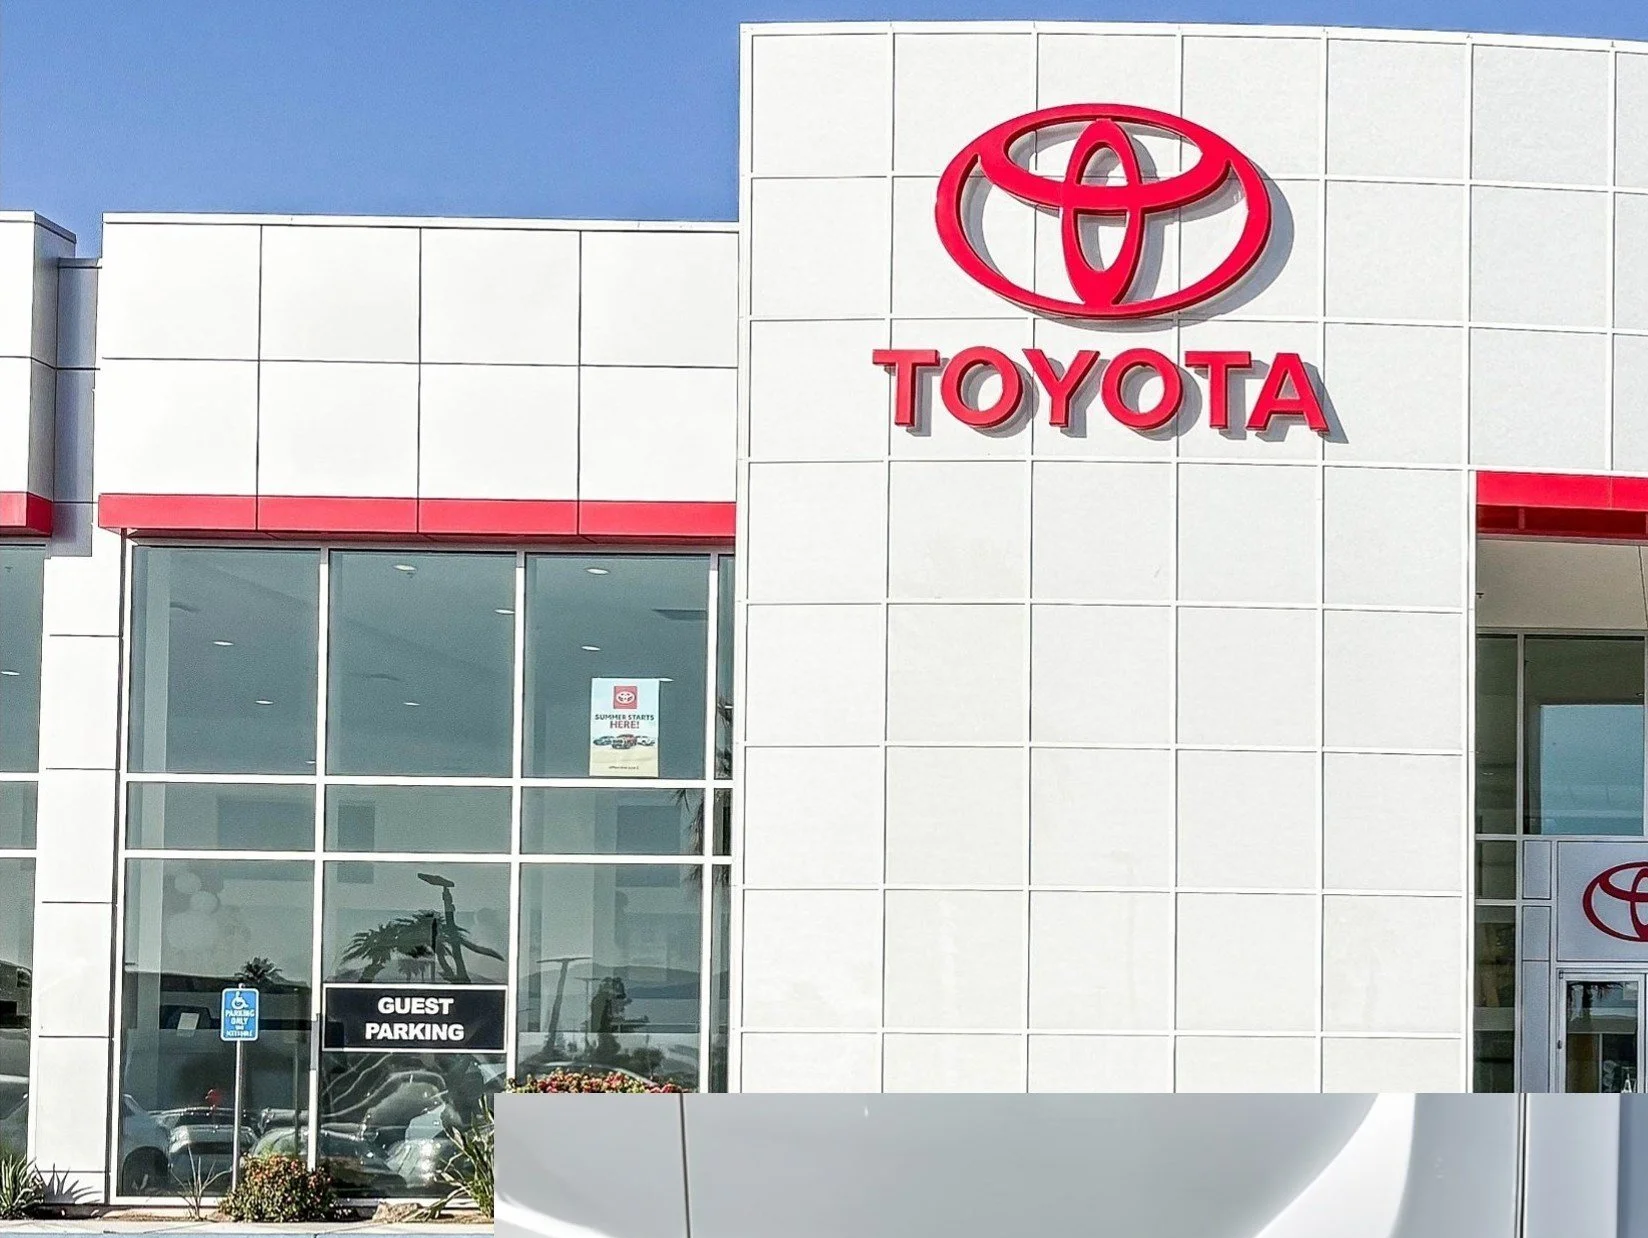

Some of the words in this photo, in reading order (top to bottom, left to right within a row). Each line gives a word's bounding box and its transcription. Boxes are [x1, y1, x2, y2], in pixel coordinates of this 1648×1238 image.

[872, 346, 1330, 433] TOYOTA
[609, 720, 640, 729] HERE!
[377, 997, 454, 1015] GUEST
[365, 1023, 465, 1041] PARKING
